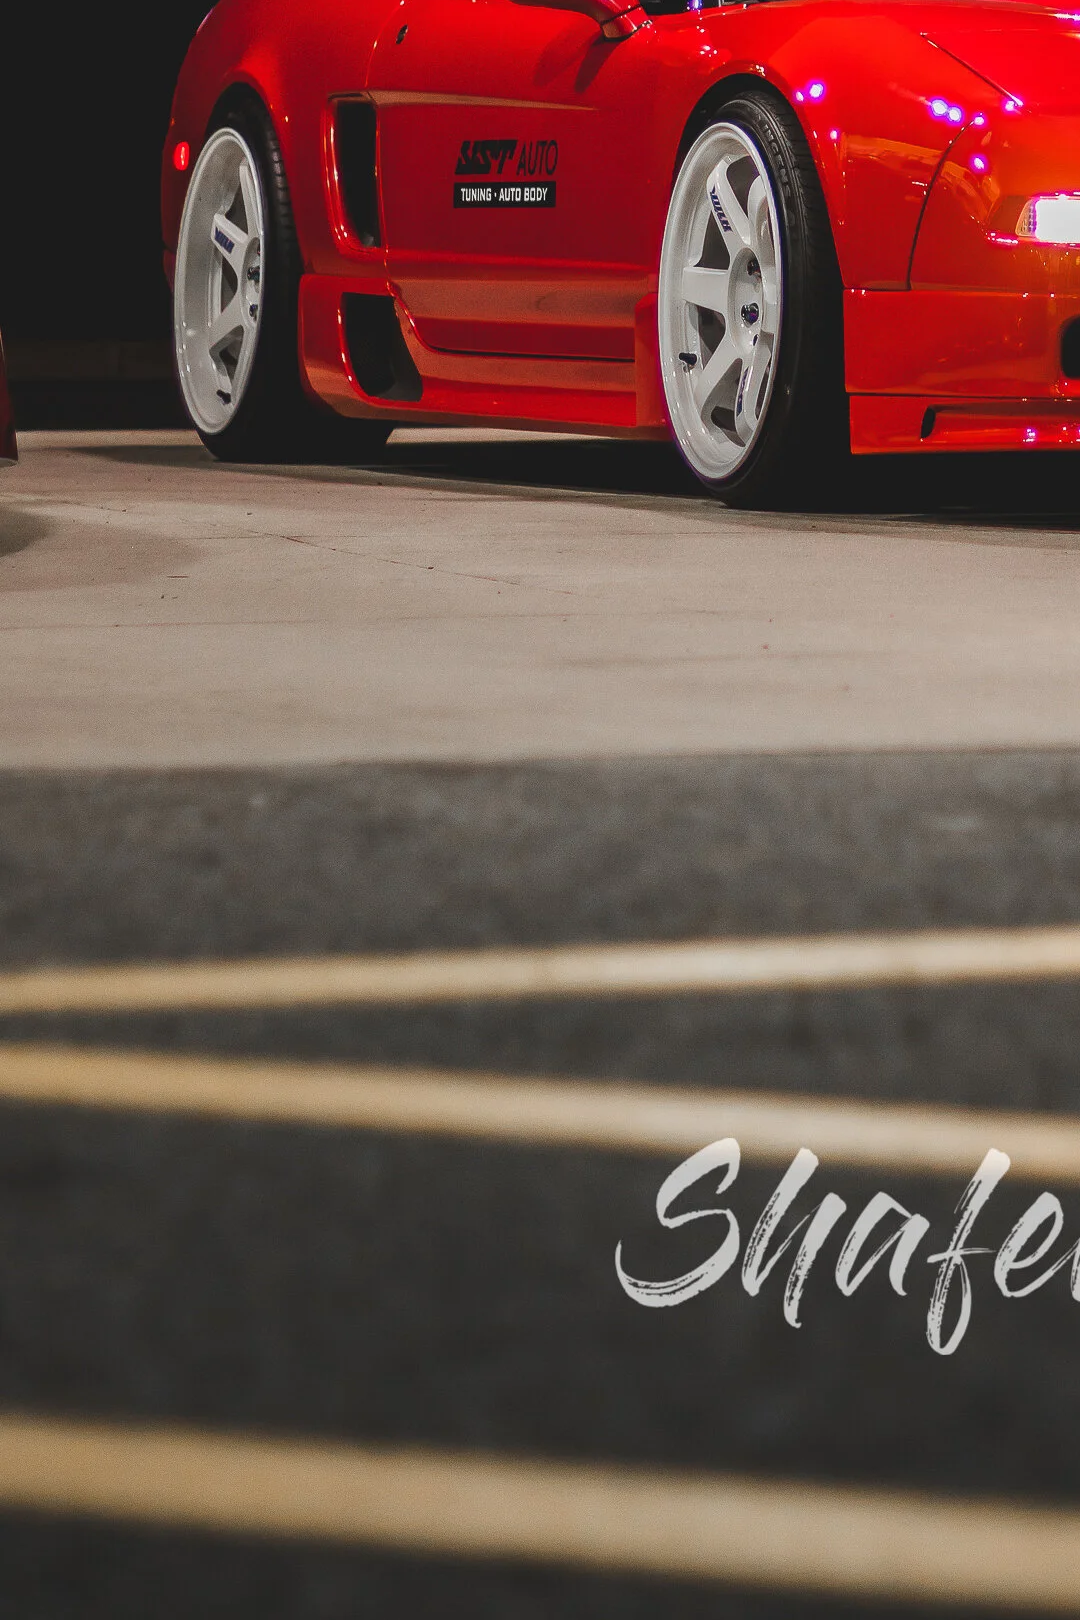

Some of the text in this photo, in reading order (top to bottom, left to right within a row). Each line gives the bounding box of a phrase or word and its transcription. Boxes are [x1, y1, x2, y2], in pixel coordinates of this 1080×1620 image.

[516, 139, 559, 176] AUTO
[460, 187, 548, 201] TUNING AUTO BODY
